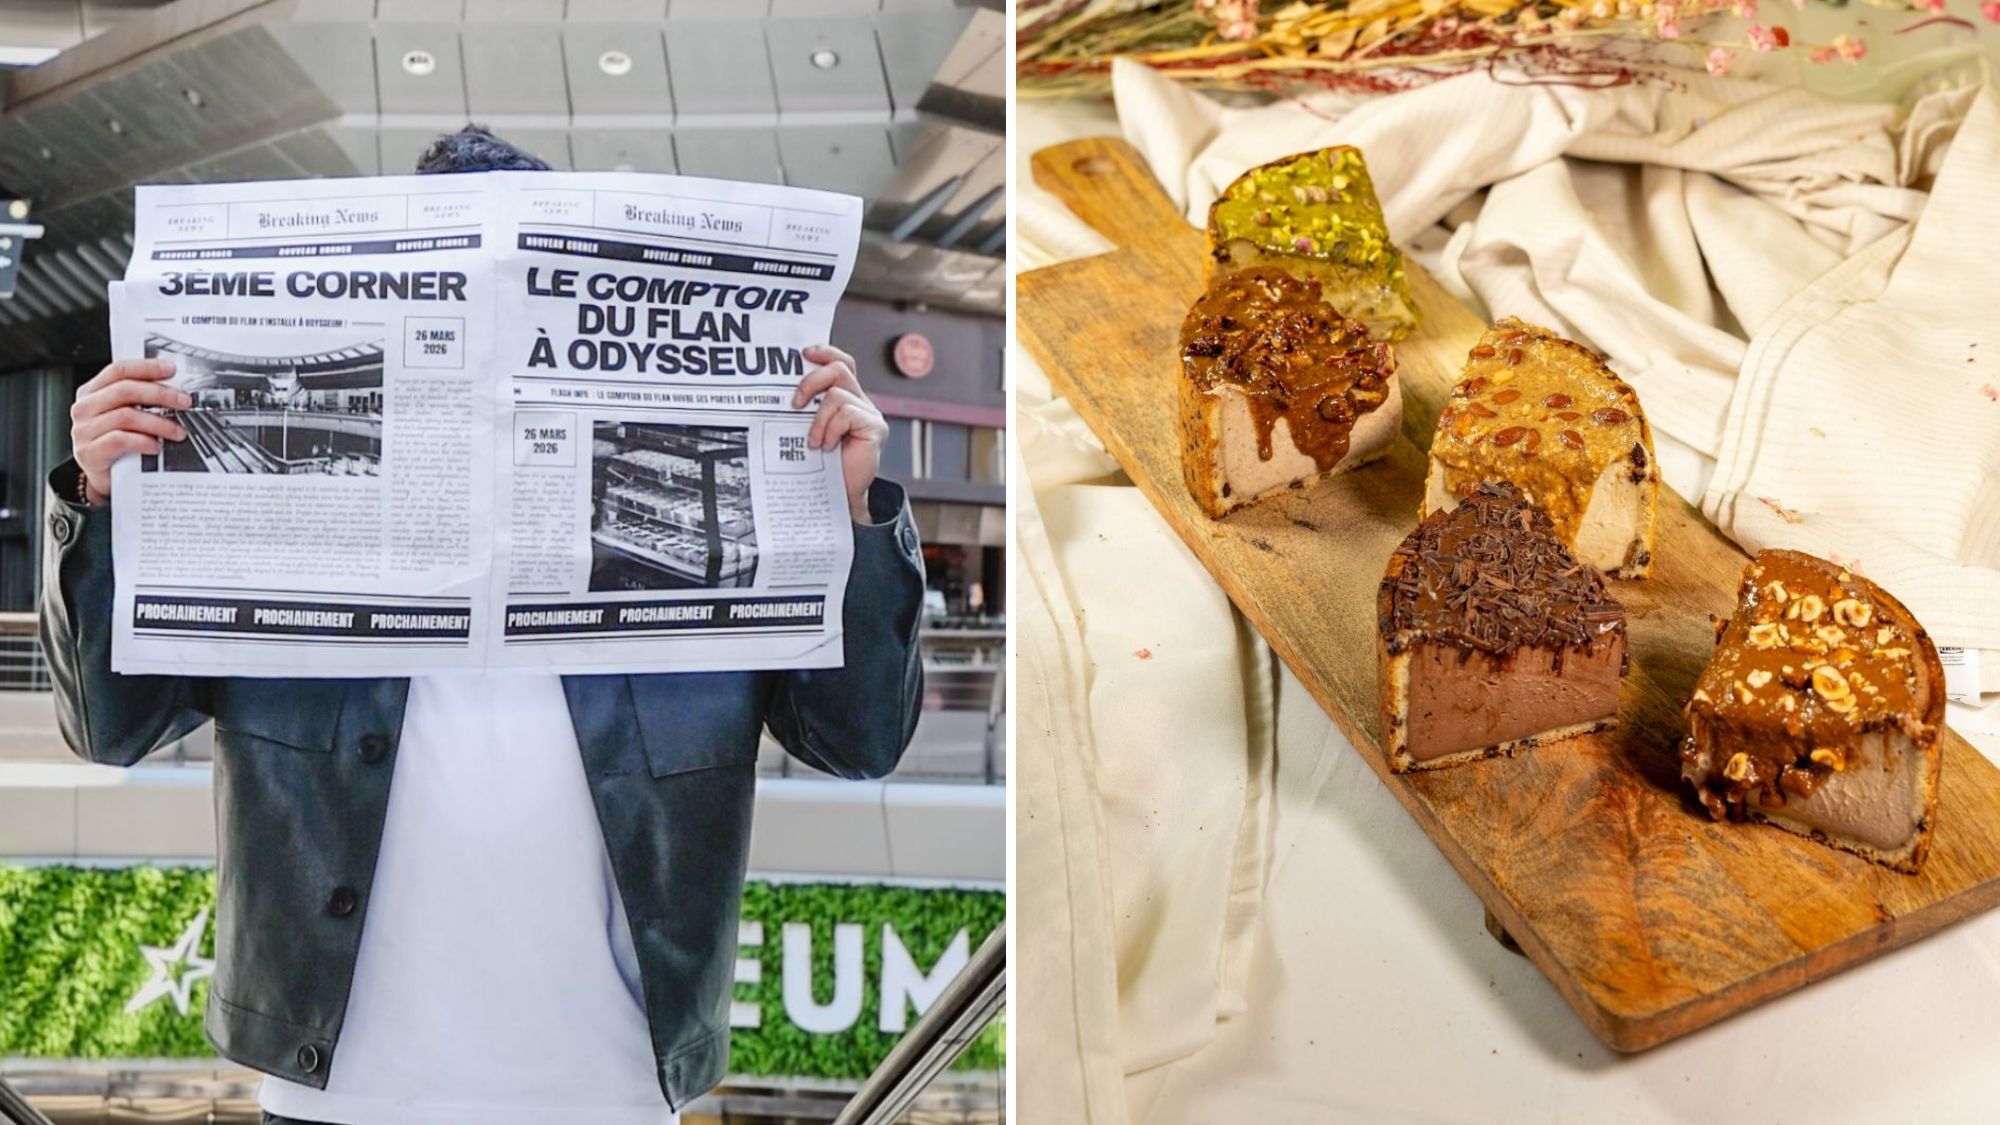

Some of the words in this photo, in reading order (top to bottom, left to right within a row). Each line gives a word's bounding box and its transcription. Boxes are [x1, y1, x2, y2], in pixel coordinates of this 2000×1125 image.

[258, 211, 330, 229] Breaking
[335, 208, 378, 224] News
[624, 204, 696, 230] Breaking
[700, 212, 742, 233] News
[159, 250, 198, 259] NOUVEAU
[200, 250, 233, 258] CORNER
[278, 246, 317, 256] NOUVEAU
[320, 244, 352, 254] CORNER
[396, 240, 434, 251] NOUVEAU
[436, 238, 469, 248] CORNER
[526, 236, 564, 250] NOUVEAU
[566, 241, 599, 254] CORNER
[642, 248, 680, 263] NOUVEAU
[681, 252, 712, 266] CORNER
[753, 260, 789, 274] NOUVEAU
[790, 265, 822, 277] CORNER
[158, 268, 275, 297] 3ÈME
[286, 271, 467, 302] CORNER
[526, 267, 580, 298] LE
[587, 272, 810, 314] COMPTOIR
[416, 330, 428, 341] 26
[430, 330, 456, 342] MARS
[578, 303, 635, 336] DU
[647, 308, 750, 342] FLAN
[424, 343, 448, 354] 2026
[527, 328, 557, 368] À
[568, 338, 804, 376] ODYSSEUM
[524, 428, 536, 440] 26
[540, 428, 566, 440] MARS
[533, 442, 558, 454] 2026
[779, 436, 805, 448] SOYEZ
[136, 602, 238, 624] PROCHAINEMENT
[254, 608, 354, 629] PROCHAINEMENT
[370, 613, 470, 631] PROCHAINEMENT
[508, 609, 604, 628] PROCHAINEMENT
[618, 605, 715, 623] PROCHAINEMENT
[729, 600, 824, 620] PROCHAINEMENT
